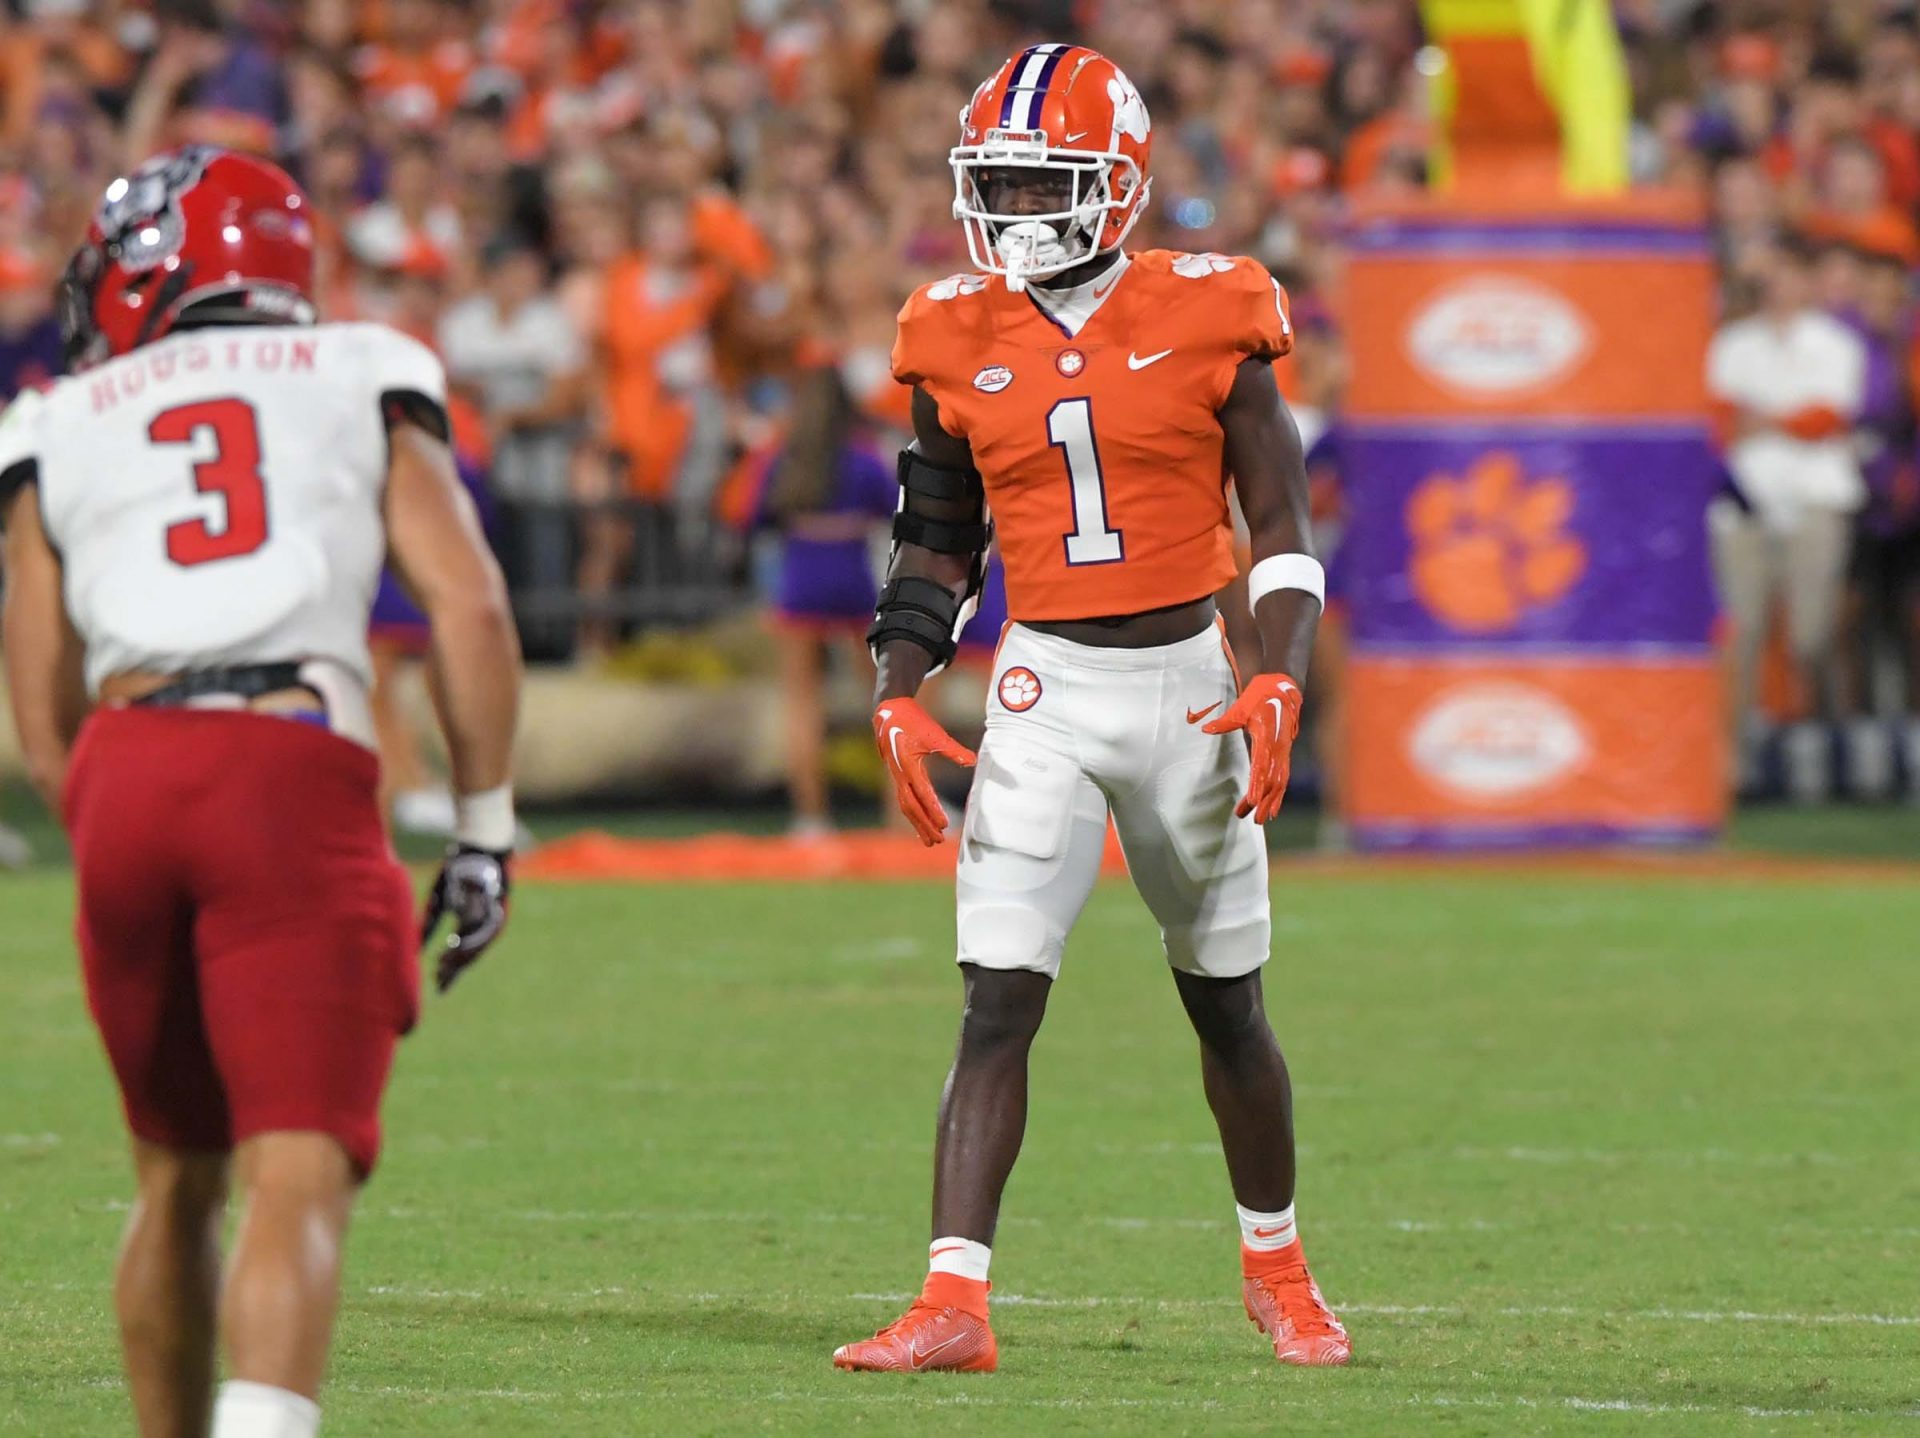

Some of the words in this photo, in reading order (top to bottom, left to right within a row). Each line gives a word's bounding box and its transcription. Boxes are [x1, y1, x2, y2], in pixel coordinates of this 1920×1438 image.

[90, 339, 318, 414] HOUSTON
[980, 370, 1008, 384] ACC
[147, 396, 269, 568] 3
[1045, 396, 1125, 567] 1
